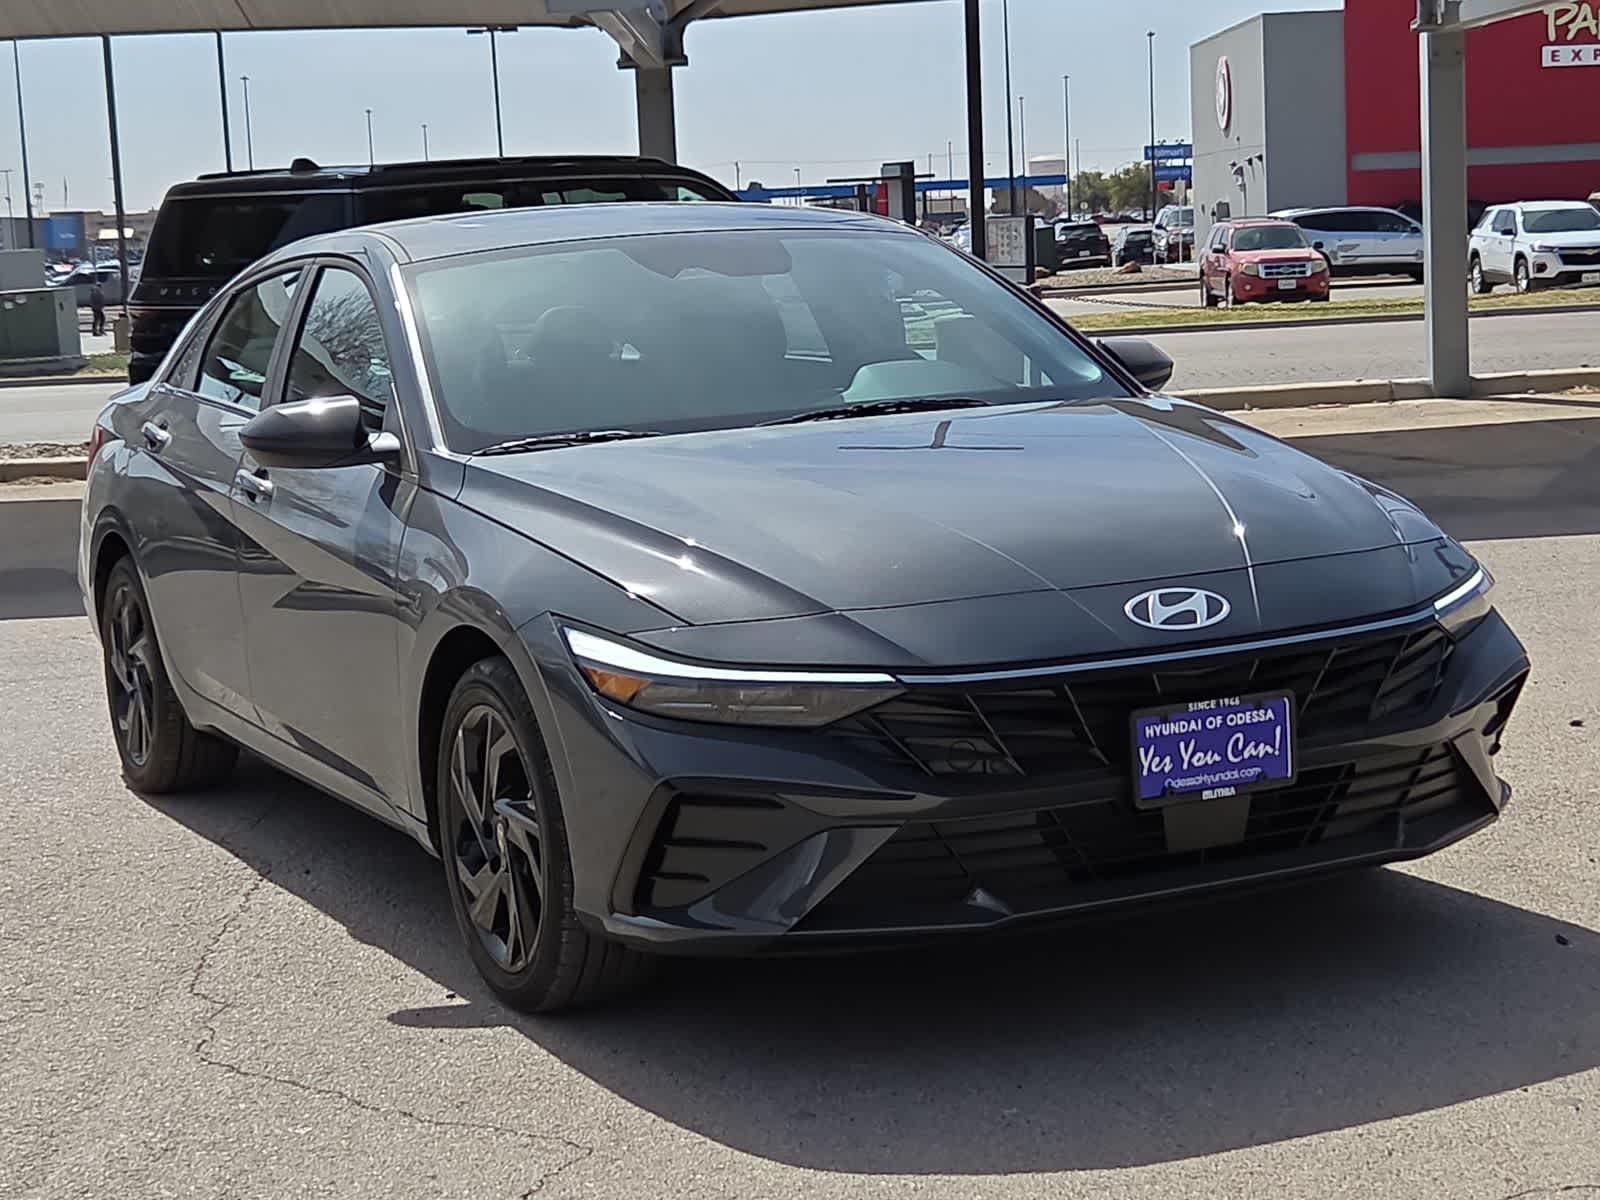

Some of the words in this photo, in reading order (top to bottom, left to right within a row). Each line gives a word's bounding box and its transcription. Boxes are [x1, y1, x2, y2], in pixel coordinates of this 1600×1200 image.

[1543, 2, 1600, 42] PA
[1145, 719, 1202, 738] HYUNDAI
[1205, 716, 1223, 730] OF
[1226, 708, 1275, 726] ODESSA
[1139, 745, 1174, 776] Yes
[1179, 739, 1222, 770] You
[1227, 725, 1282, 763] Can!
